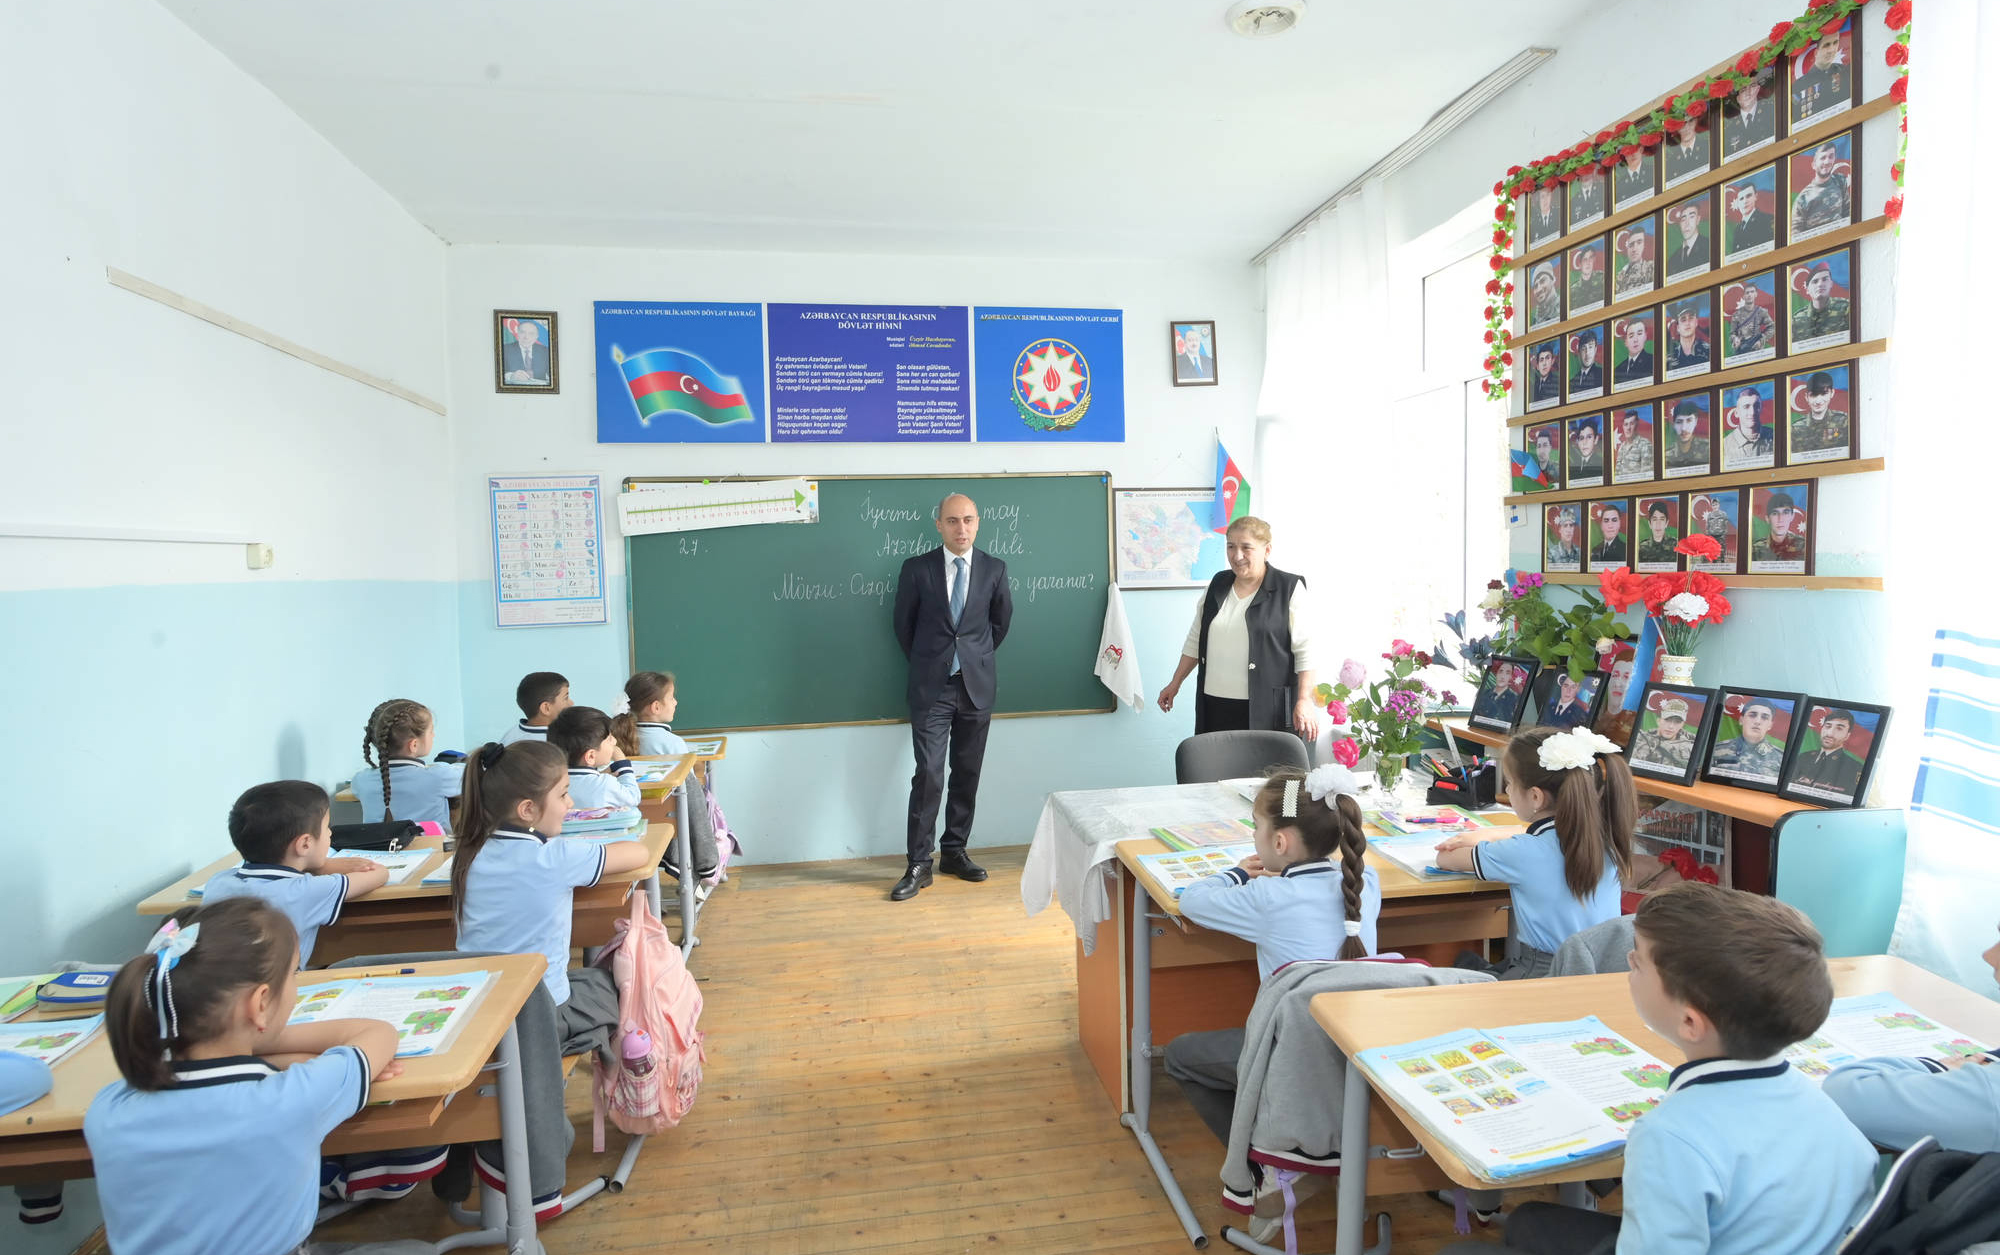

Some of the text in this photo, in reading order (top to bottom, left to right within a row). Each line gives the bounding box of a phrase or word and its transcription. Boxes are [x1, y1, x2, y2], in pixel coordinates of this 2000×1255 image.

[800, 313, 937, 321] AZƏRBAYCAN RESPUBLİKASININ
[838, 321, 902, 330] DÖVLƏT HİMNİ
[877, 532, 943, 557] Azərba
